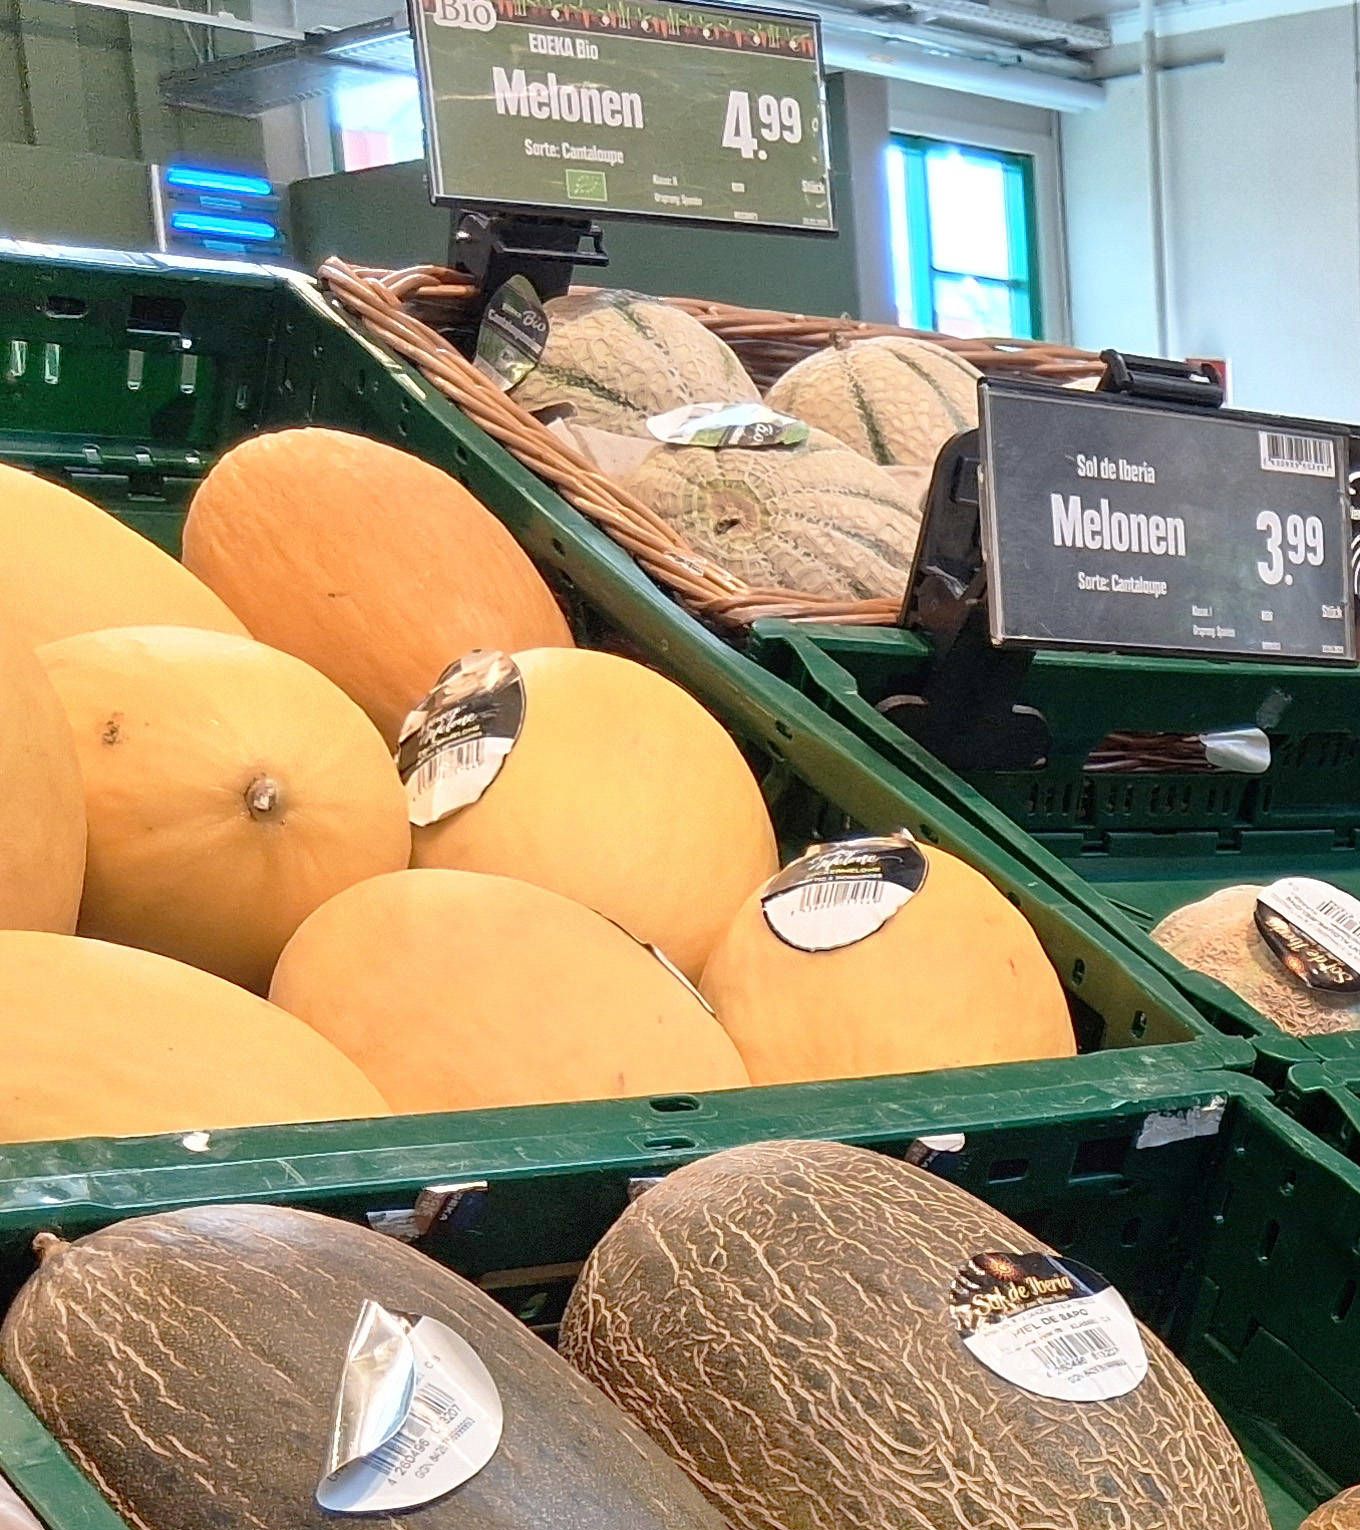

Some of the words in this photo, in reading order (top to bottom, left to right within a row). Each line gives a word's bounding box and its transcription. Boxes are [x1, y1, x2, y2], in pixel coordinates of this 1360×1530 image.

[436, 0, 491, 25] Bio
[528, 33, 574, 58] EDEKA
[576, 39, 599, 60] Bio
[492, 67, 644, 128] Melonen
[722, 90, 803, 160] 4.99
[524, 139, 560, 160] Sorte:
[562, 142, 624, 166] Cantaloupe
[523, 310, 546, 332] Bio
[1077, 454, 1096, 478] Sol
[1099, 457, 1116, 480] de
[1118, 459, 1155, 483] Iberia
[1050, 493, 1186, 557] Melonen
[1255, 510, 1325, 586] 3.99
[1078, 571, 1109, 592] Sorte:
[1111, 574, 1167, 598] Cantaloupe
